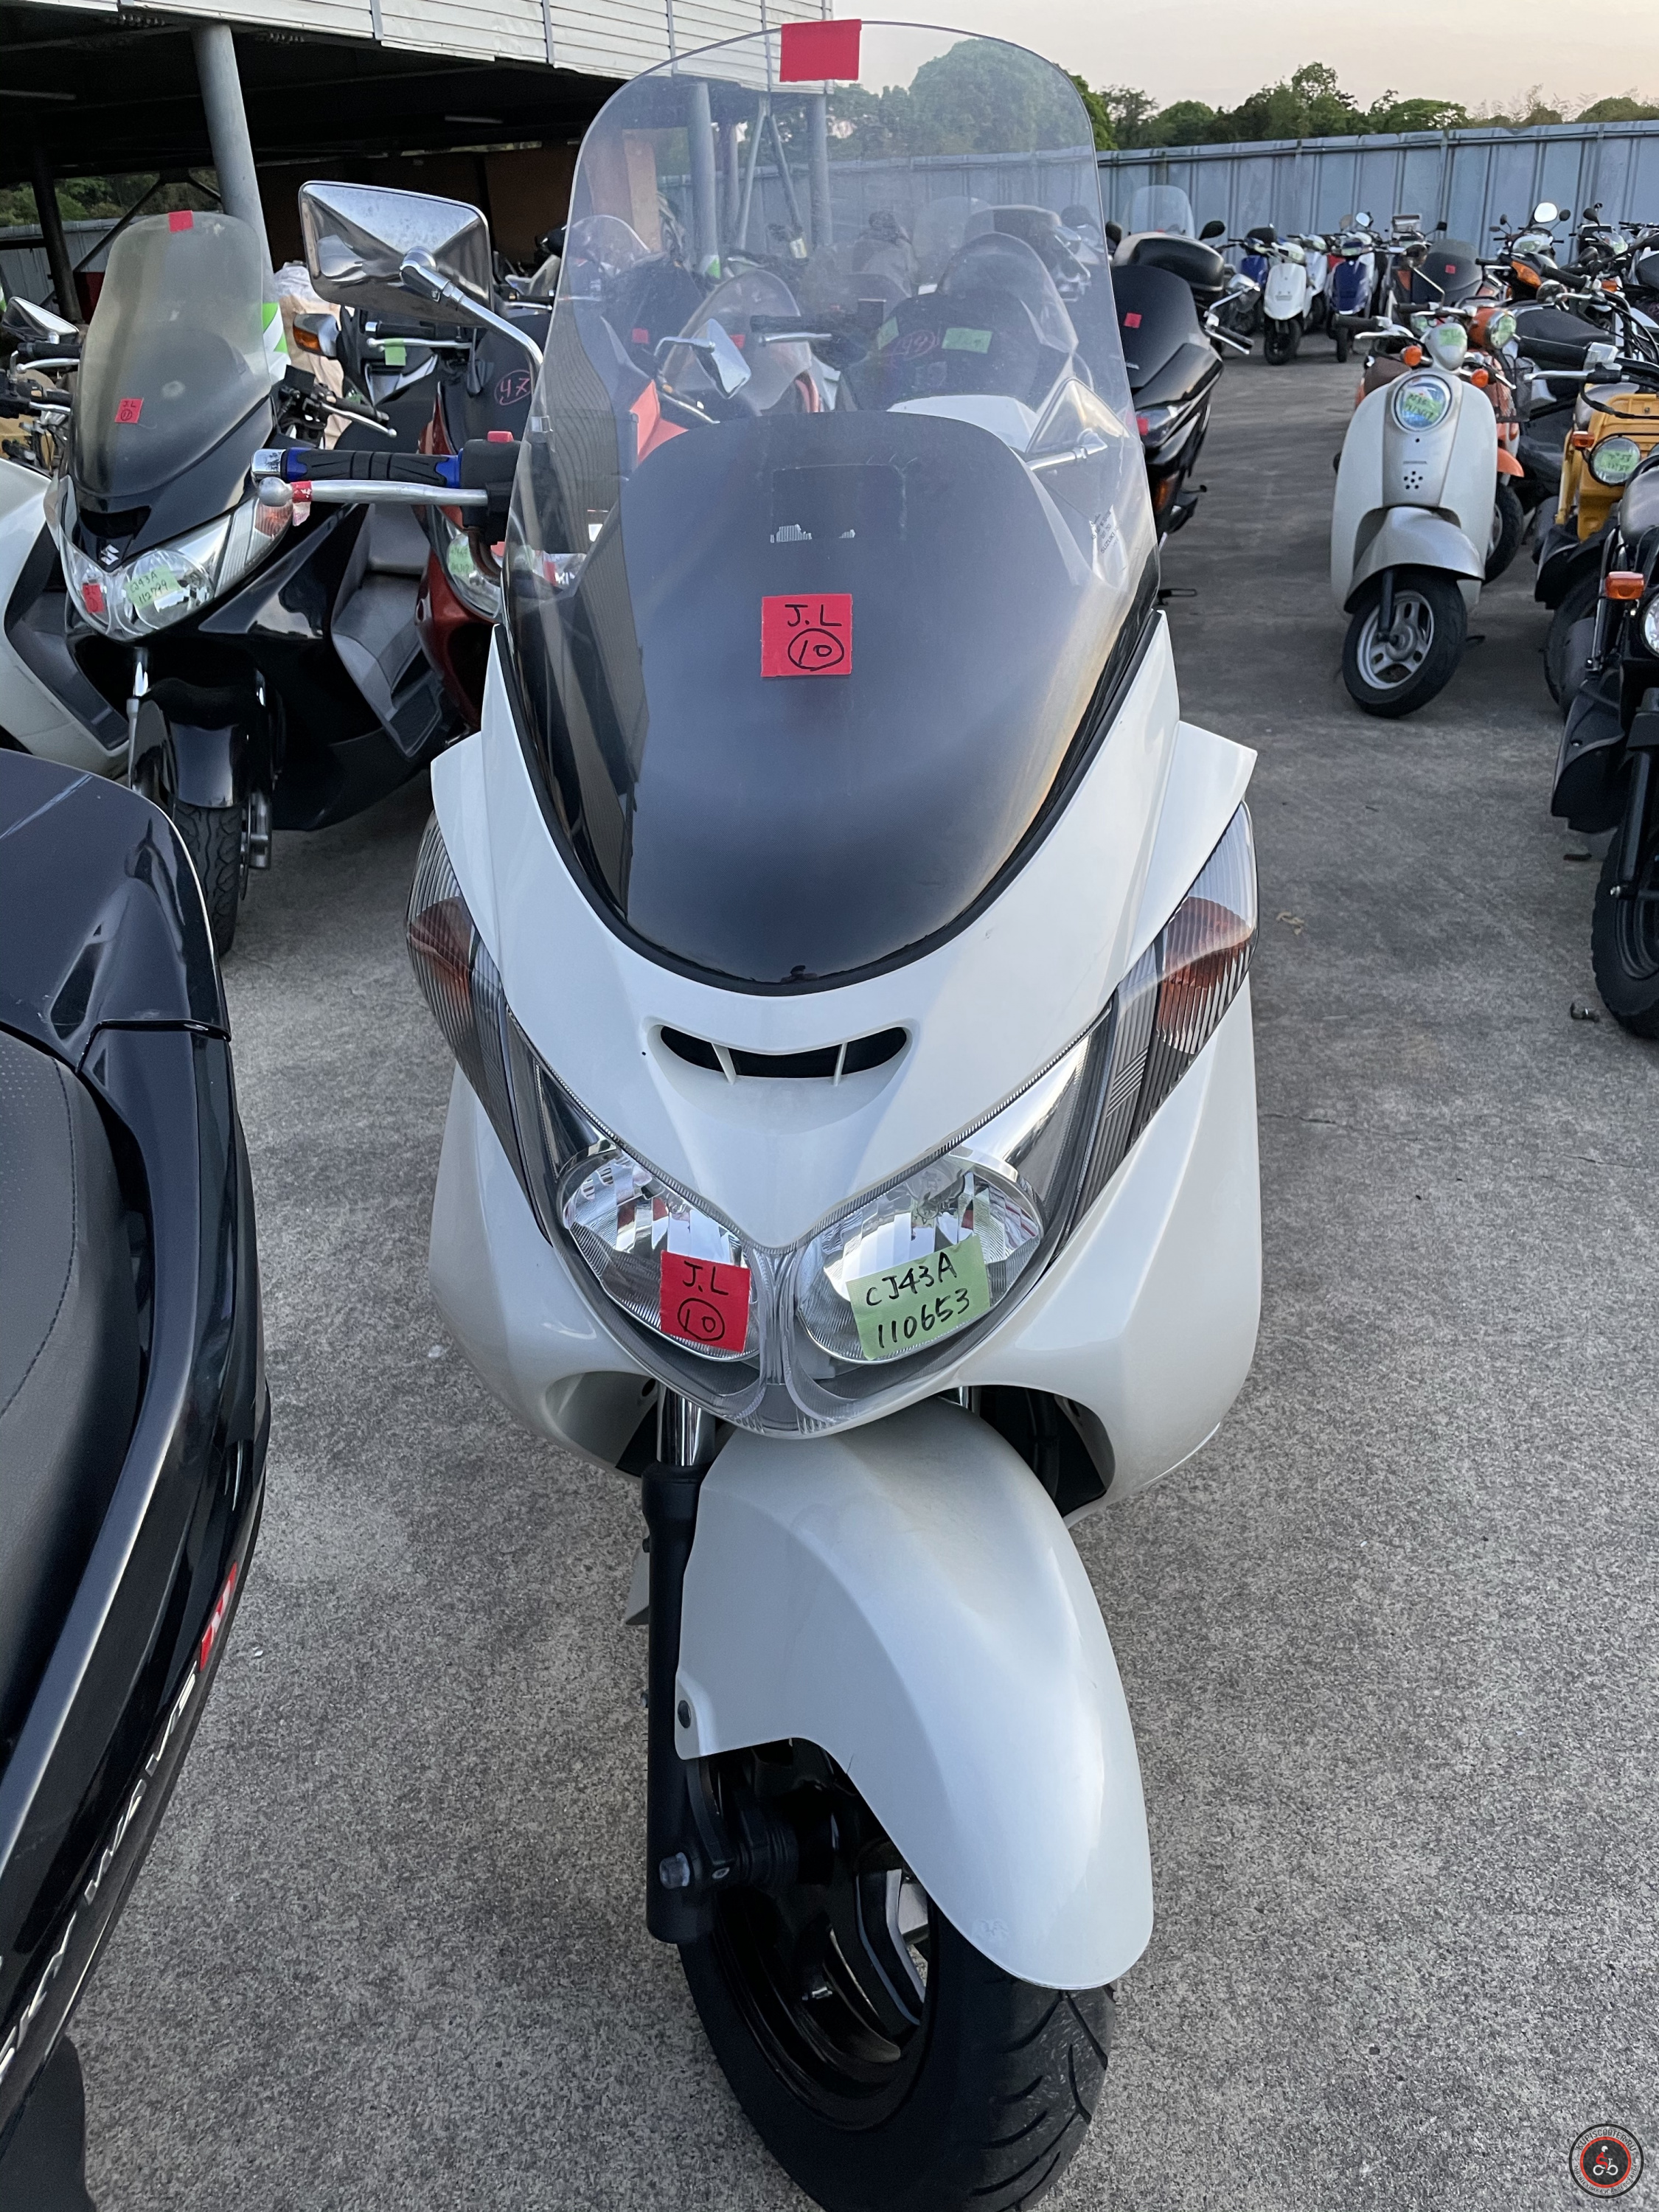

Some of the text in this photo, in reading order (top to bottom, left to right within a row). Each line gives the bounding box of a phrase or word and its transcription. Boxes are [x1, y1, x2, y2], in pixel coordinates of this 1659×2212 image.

[500, 378, 530, 398] 47
[1100, 531, 1116, 554] SUZUKI
[784, 603, 843, 627] J.L
[682, 1260, 729, 1295] J.L
[865, 1251, 958, 1307] CJ43A
[877, 1287, 971, 1349] 110653
[84, 1660, 198, 1906] WAVE
